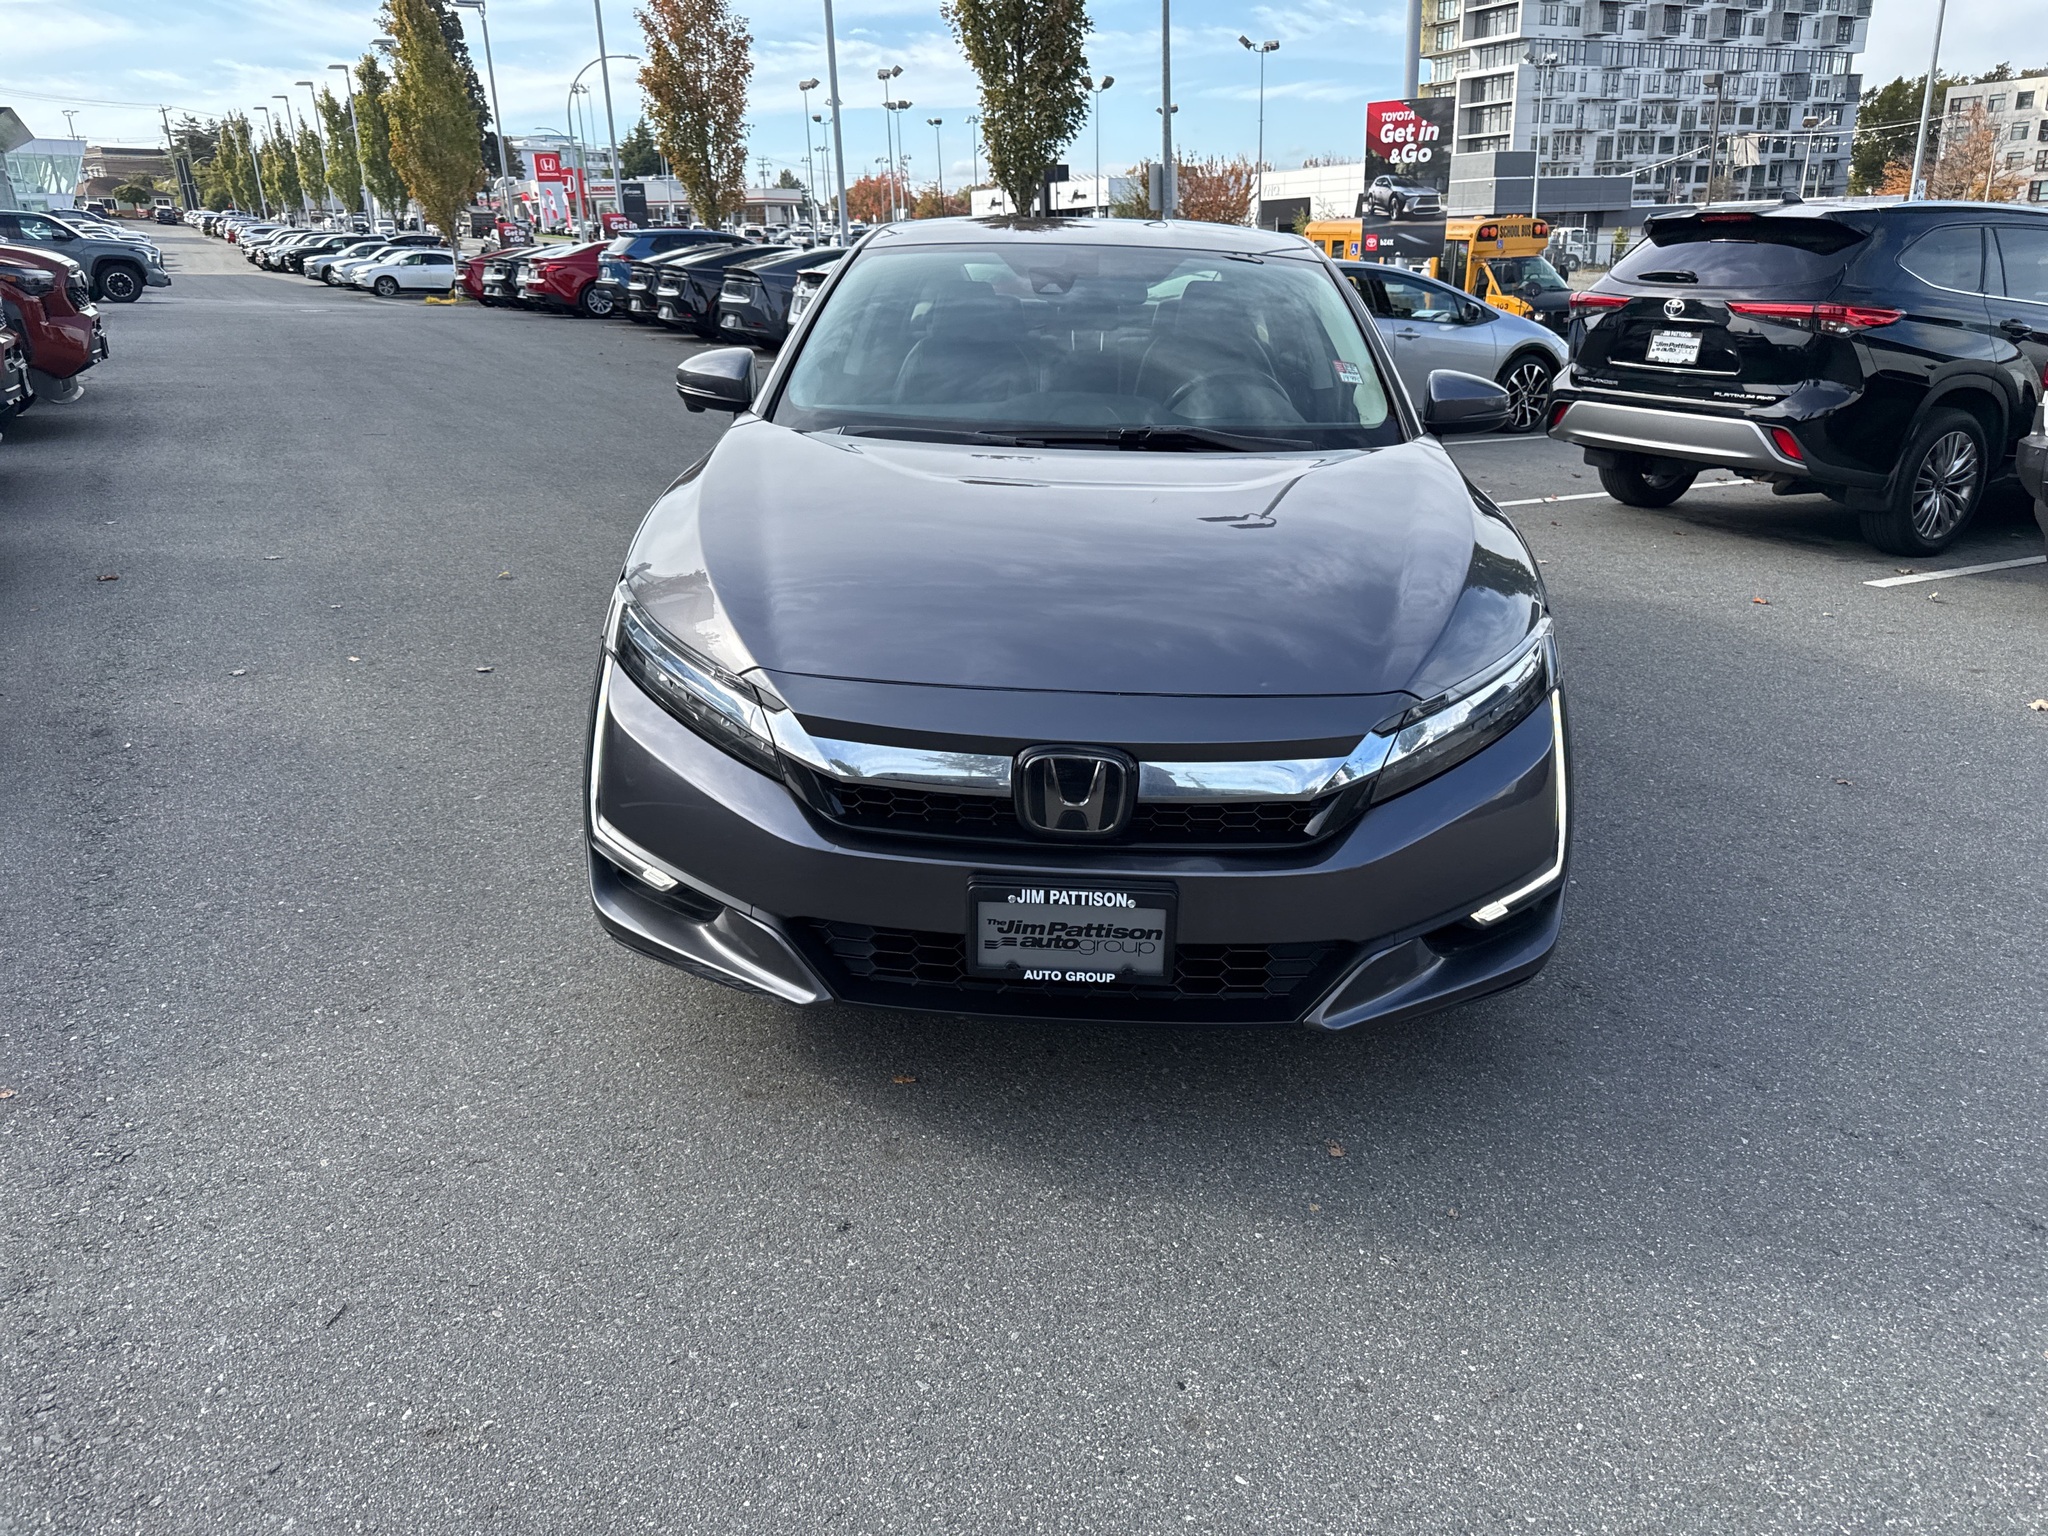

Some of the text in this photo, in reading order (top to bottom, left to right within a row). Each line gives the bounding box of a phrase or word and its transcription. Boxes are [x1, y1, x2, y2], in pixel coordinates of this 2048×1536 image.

[1381, 110, 1415, 122] TOYOTA
[1380, 120, 1440, 143] Get in
[1389, 143, 1432, 164] &Go
[611, 220, 638, 230] Get in
[1499, 224, 1532, 238] SCHOOL BUS
[1713, 391, 1755, 399] PLATINUM
[1016, 889, 1128, 908] JIM PATTISON
[986, 918, 1163, 941] The Jim Pattison
[1024, 970, 1116, 983] AUTO GROUP
